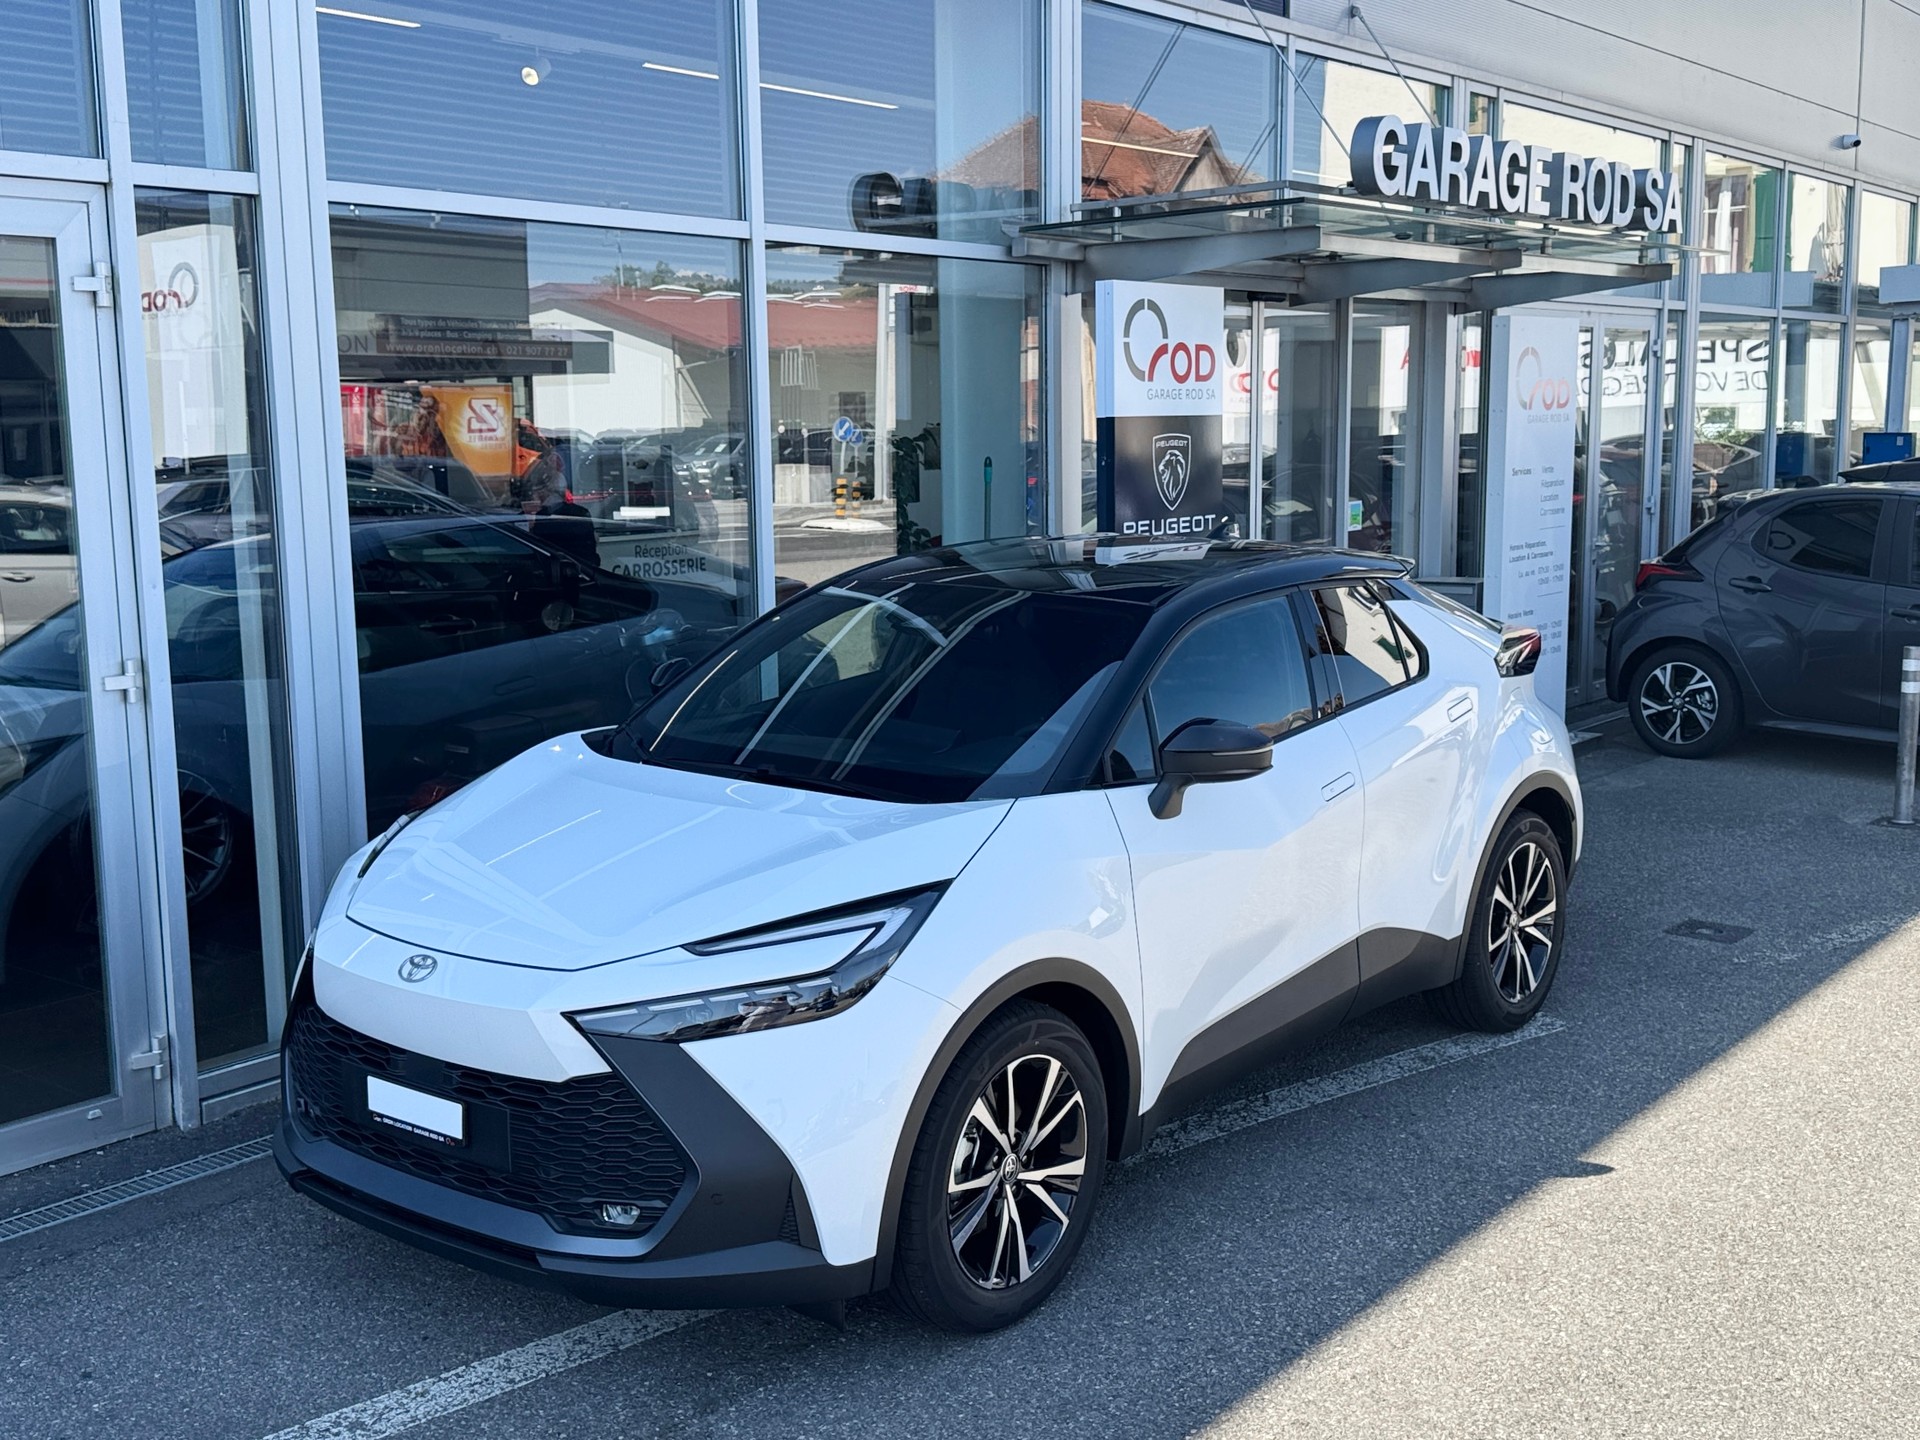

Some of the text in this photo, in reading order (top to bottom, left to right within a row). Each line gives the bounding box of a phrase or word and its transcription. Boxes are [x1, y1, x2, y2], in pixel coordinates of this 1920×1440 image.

[1369, 114, 1684, 234] GARAGE ROD SA
[1146, 388, 1183, 401] GARAGE
[1185, 388, 1204, 400] ROD
[1206, 388, 1216, 400] SA
[1155, 440, 1188, 449] PEUGEOT
[1122, 513, 1217, 536] PEUGEOT
[634, 543, 688, 560] Réception
[612, 556, 707, 578] CARROSSERIE
